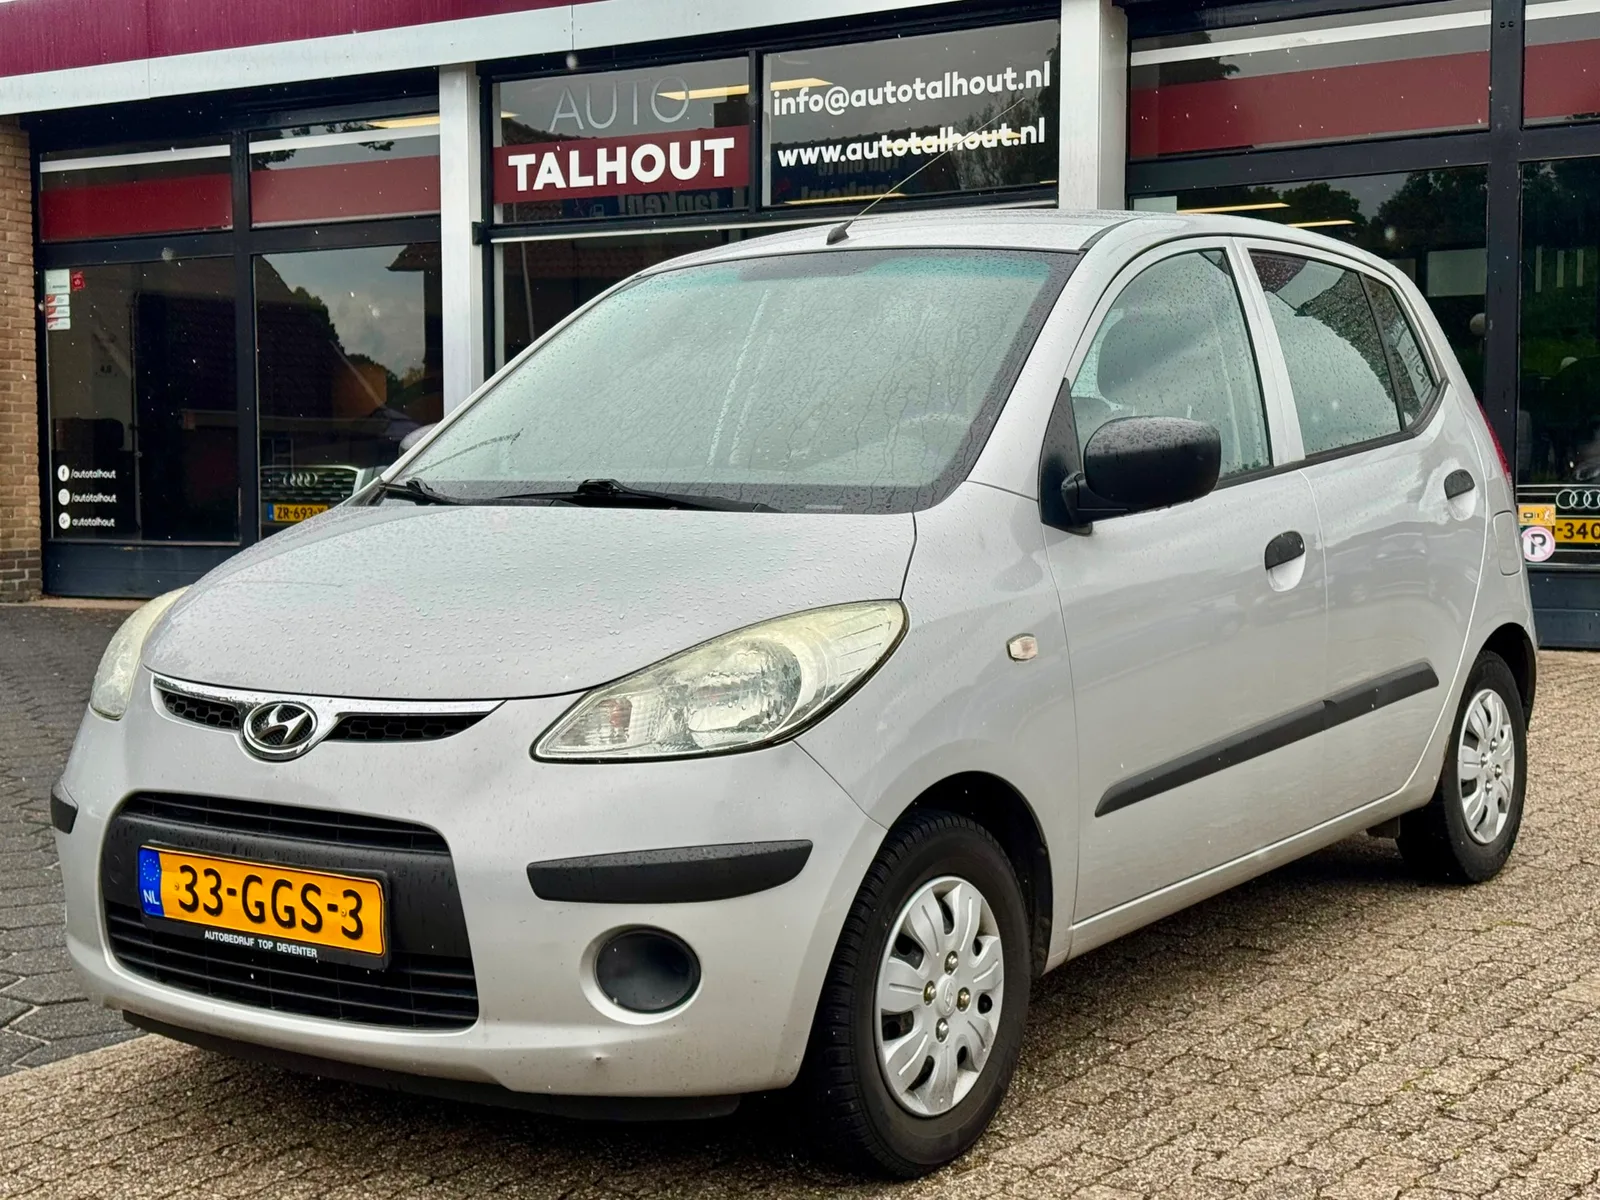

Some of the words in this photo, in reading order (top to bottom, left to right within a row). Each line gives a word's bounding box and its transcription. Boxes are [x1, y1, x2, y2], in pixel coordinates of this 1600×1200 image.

[549, 76, 689, 132] AUTO
[774, 61, 1050, 115] info@autotalhout.nl
[508, 137, 735, 191] TALHOUT
[778, 117, 1045, 167] www.autotalhout.nl
[143, 889, 160, 906] NL
[178, 864, 364, 941] 33-GGS-3
[204, 930, 254, 946] AUTOBEDRIJF
[258, 939, 273, 950] TOP
[277, 943, 317, 958] DEVENTER
